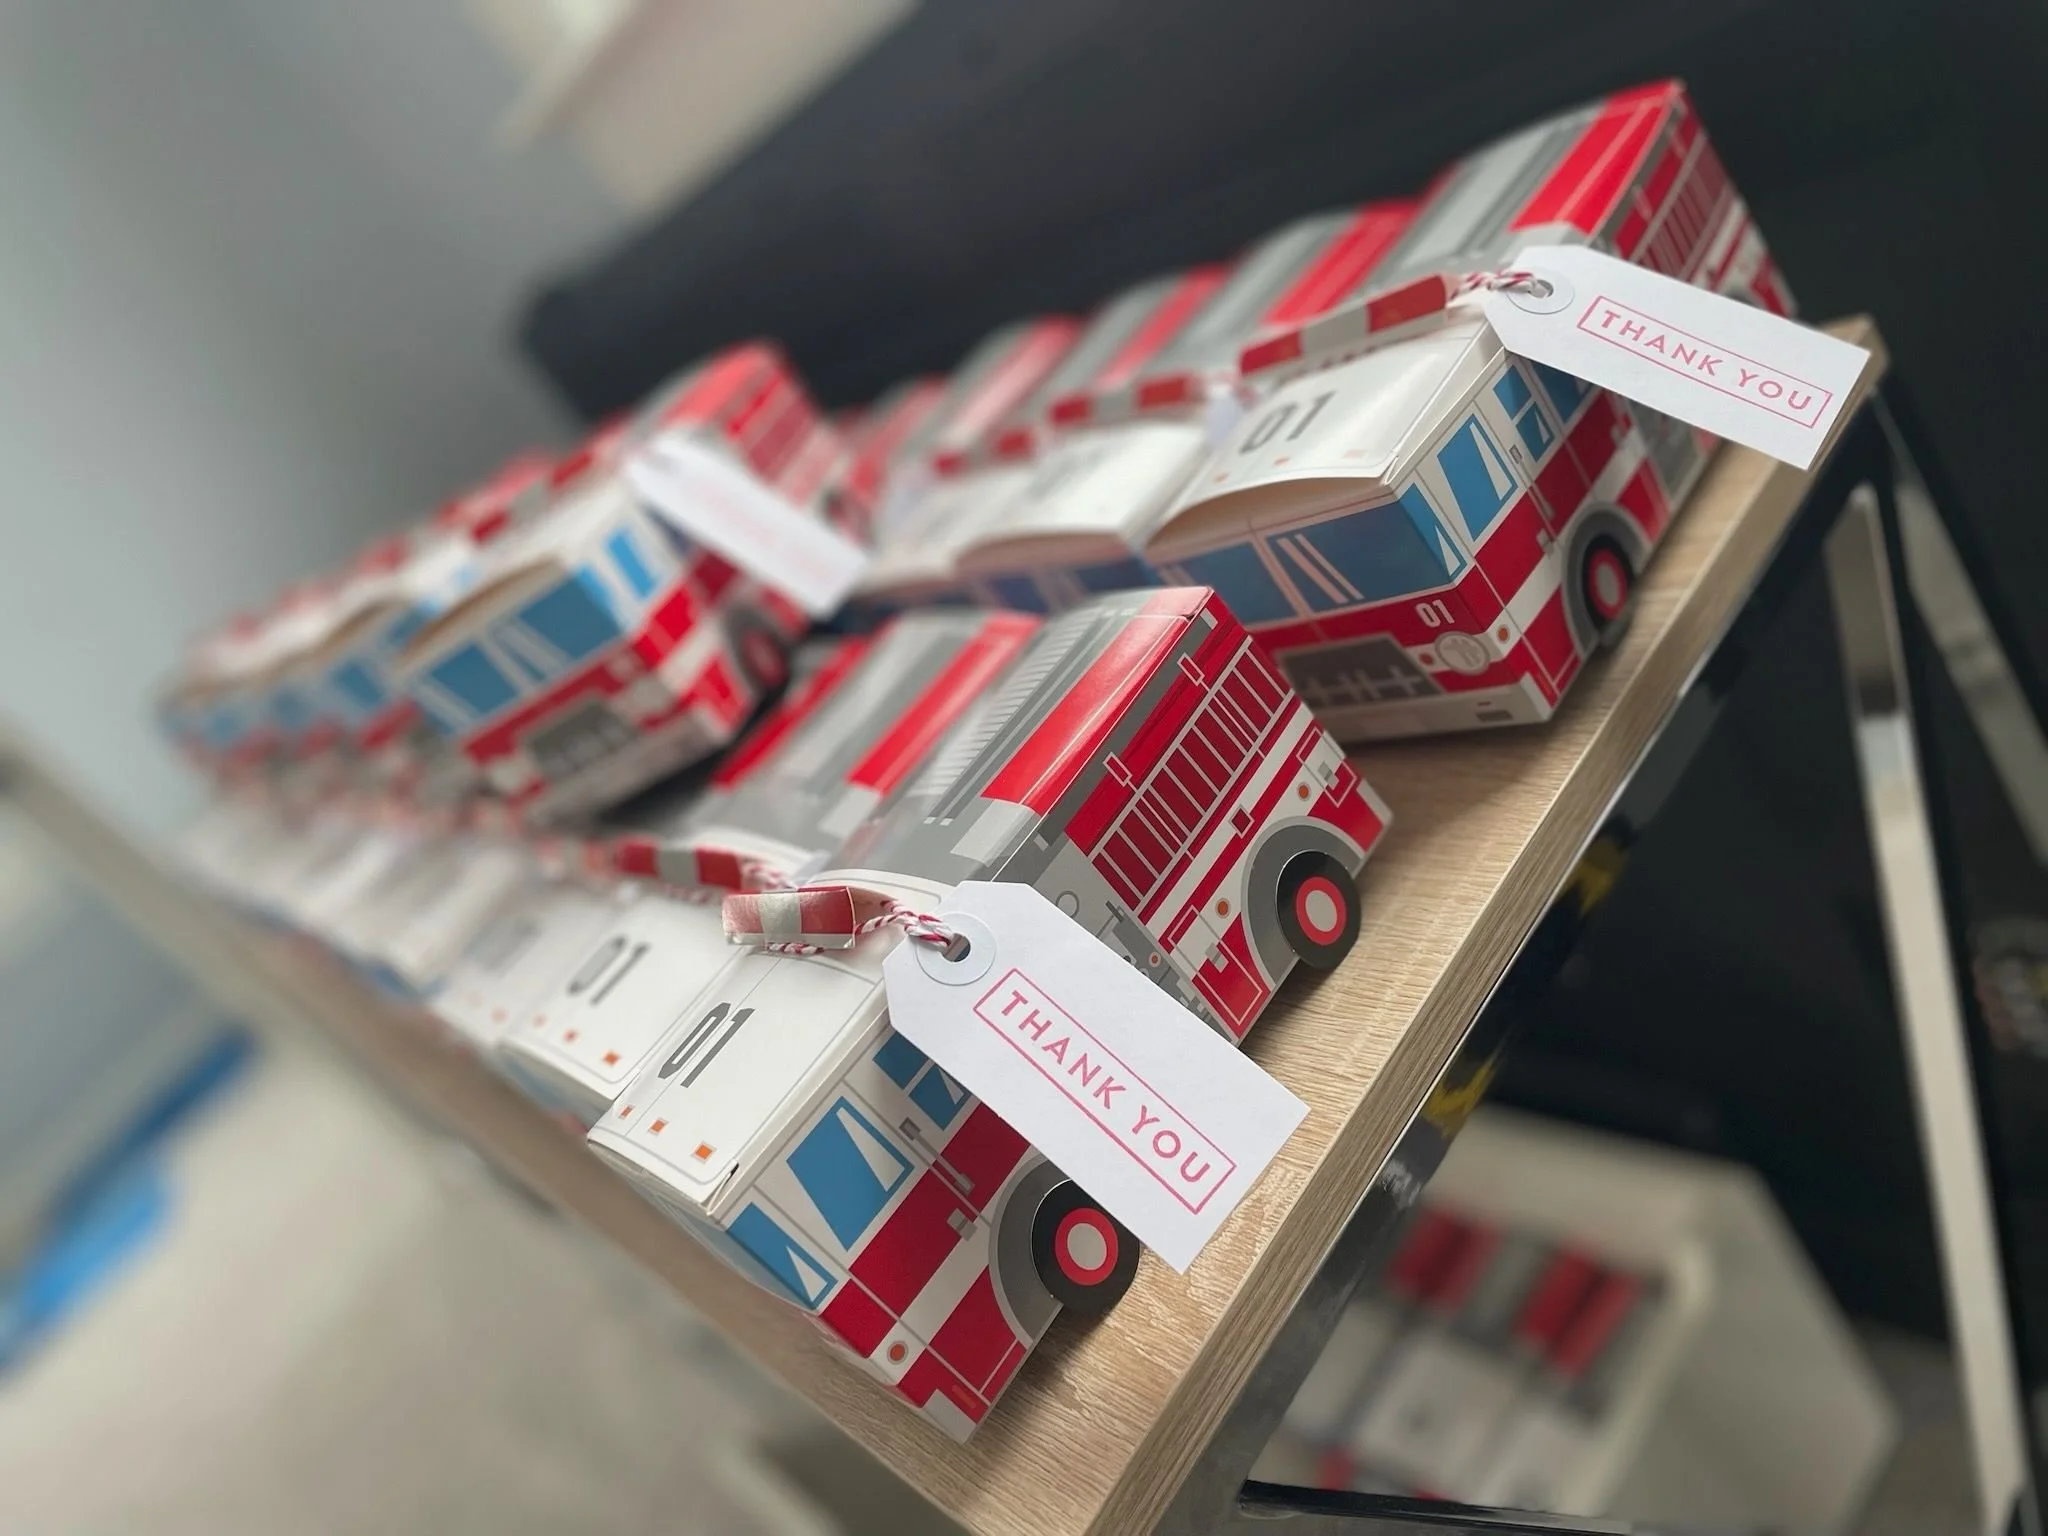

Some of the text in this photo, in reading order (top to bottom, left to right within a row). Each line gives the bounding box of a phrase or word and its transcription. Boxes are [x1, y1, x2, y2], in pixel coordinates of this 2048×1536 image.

[1601, 311, 1812, 411] THANK YOU
[1239, 391, 1336, 456] 01
[1416, 600, 1454, 627] 01
[567, 935, 651, 1005] 01
[659, 1002, 756, 1088] 01
[1000, 990, 1210, 1183] THANK YOU
